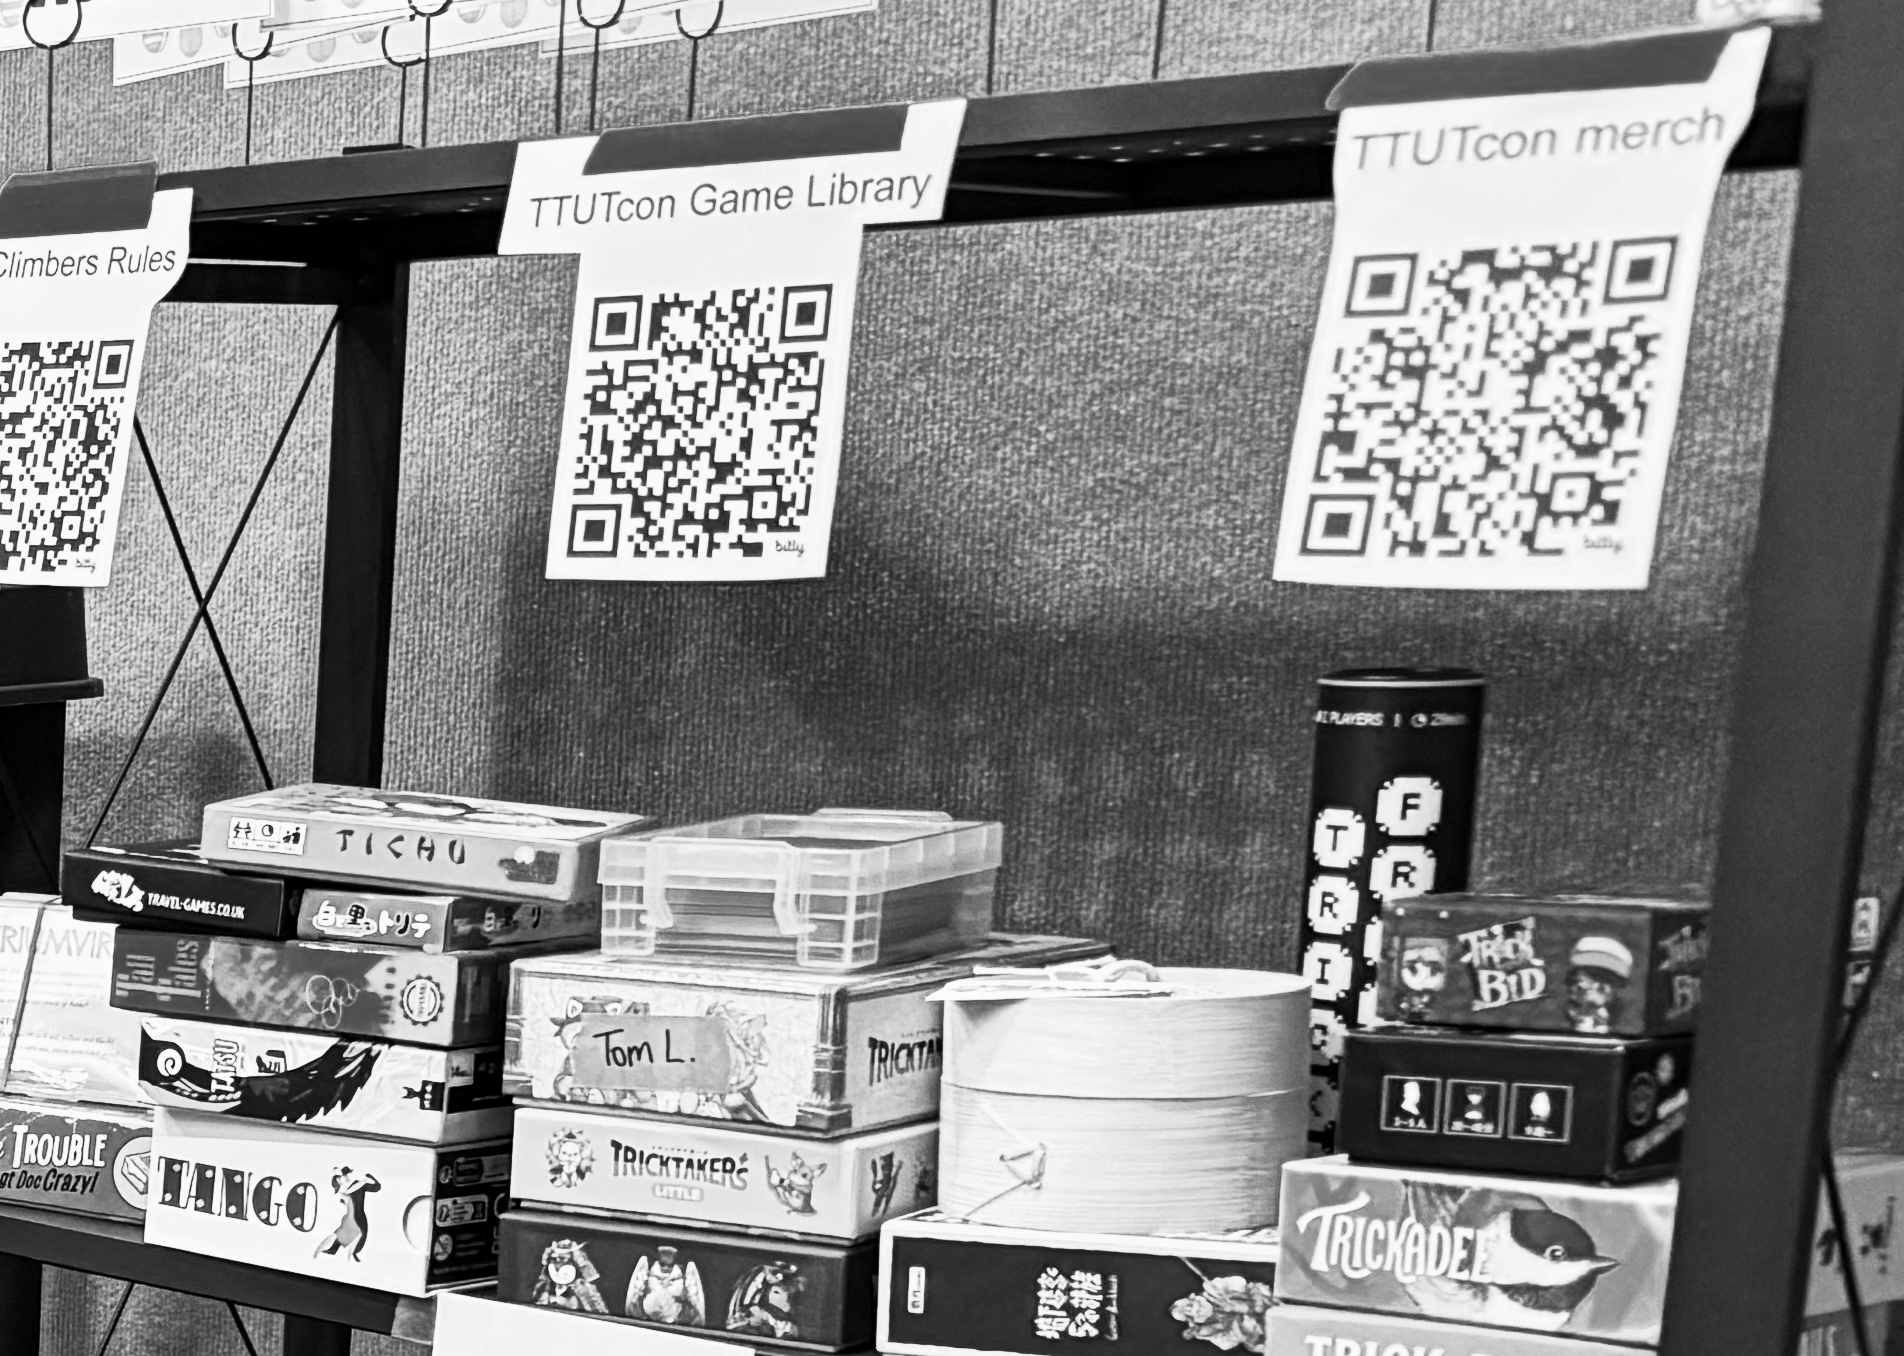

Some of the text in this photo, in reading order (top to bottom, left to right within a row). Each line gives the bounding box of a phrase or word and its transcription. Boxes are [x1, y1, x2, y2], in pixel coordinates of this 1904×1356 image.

[1352, 106, 1725, 171] TTUTcon merch
[530, 164, 933, 229] TTUTcon Game Library
[105, 245, 177, 275] Rules
[336, 830, 466, 865] TICHU
[591, 1028, 696, 1068] Tom L.
[12, 1124, 108, 1169] TROUBLE
[157, 1154, 319, 1234] TANGO
[1295, 1191, 1494, 1285] TRICKADEE
